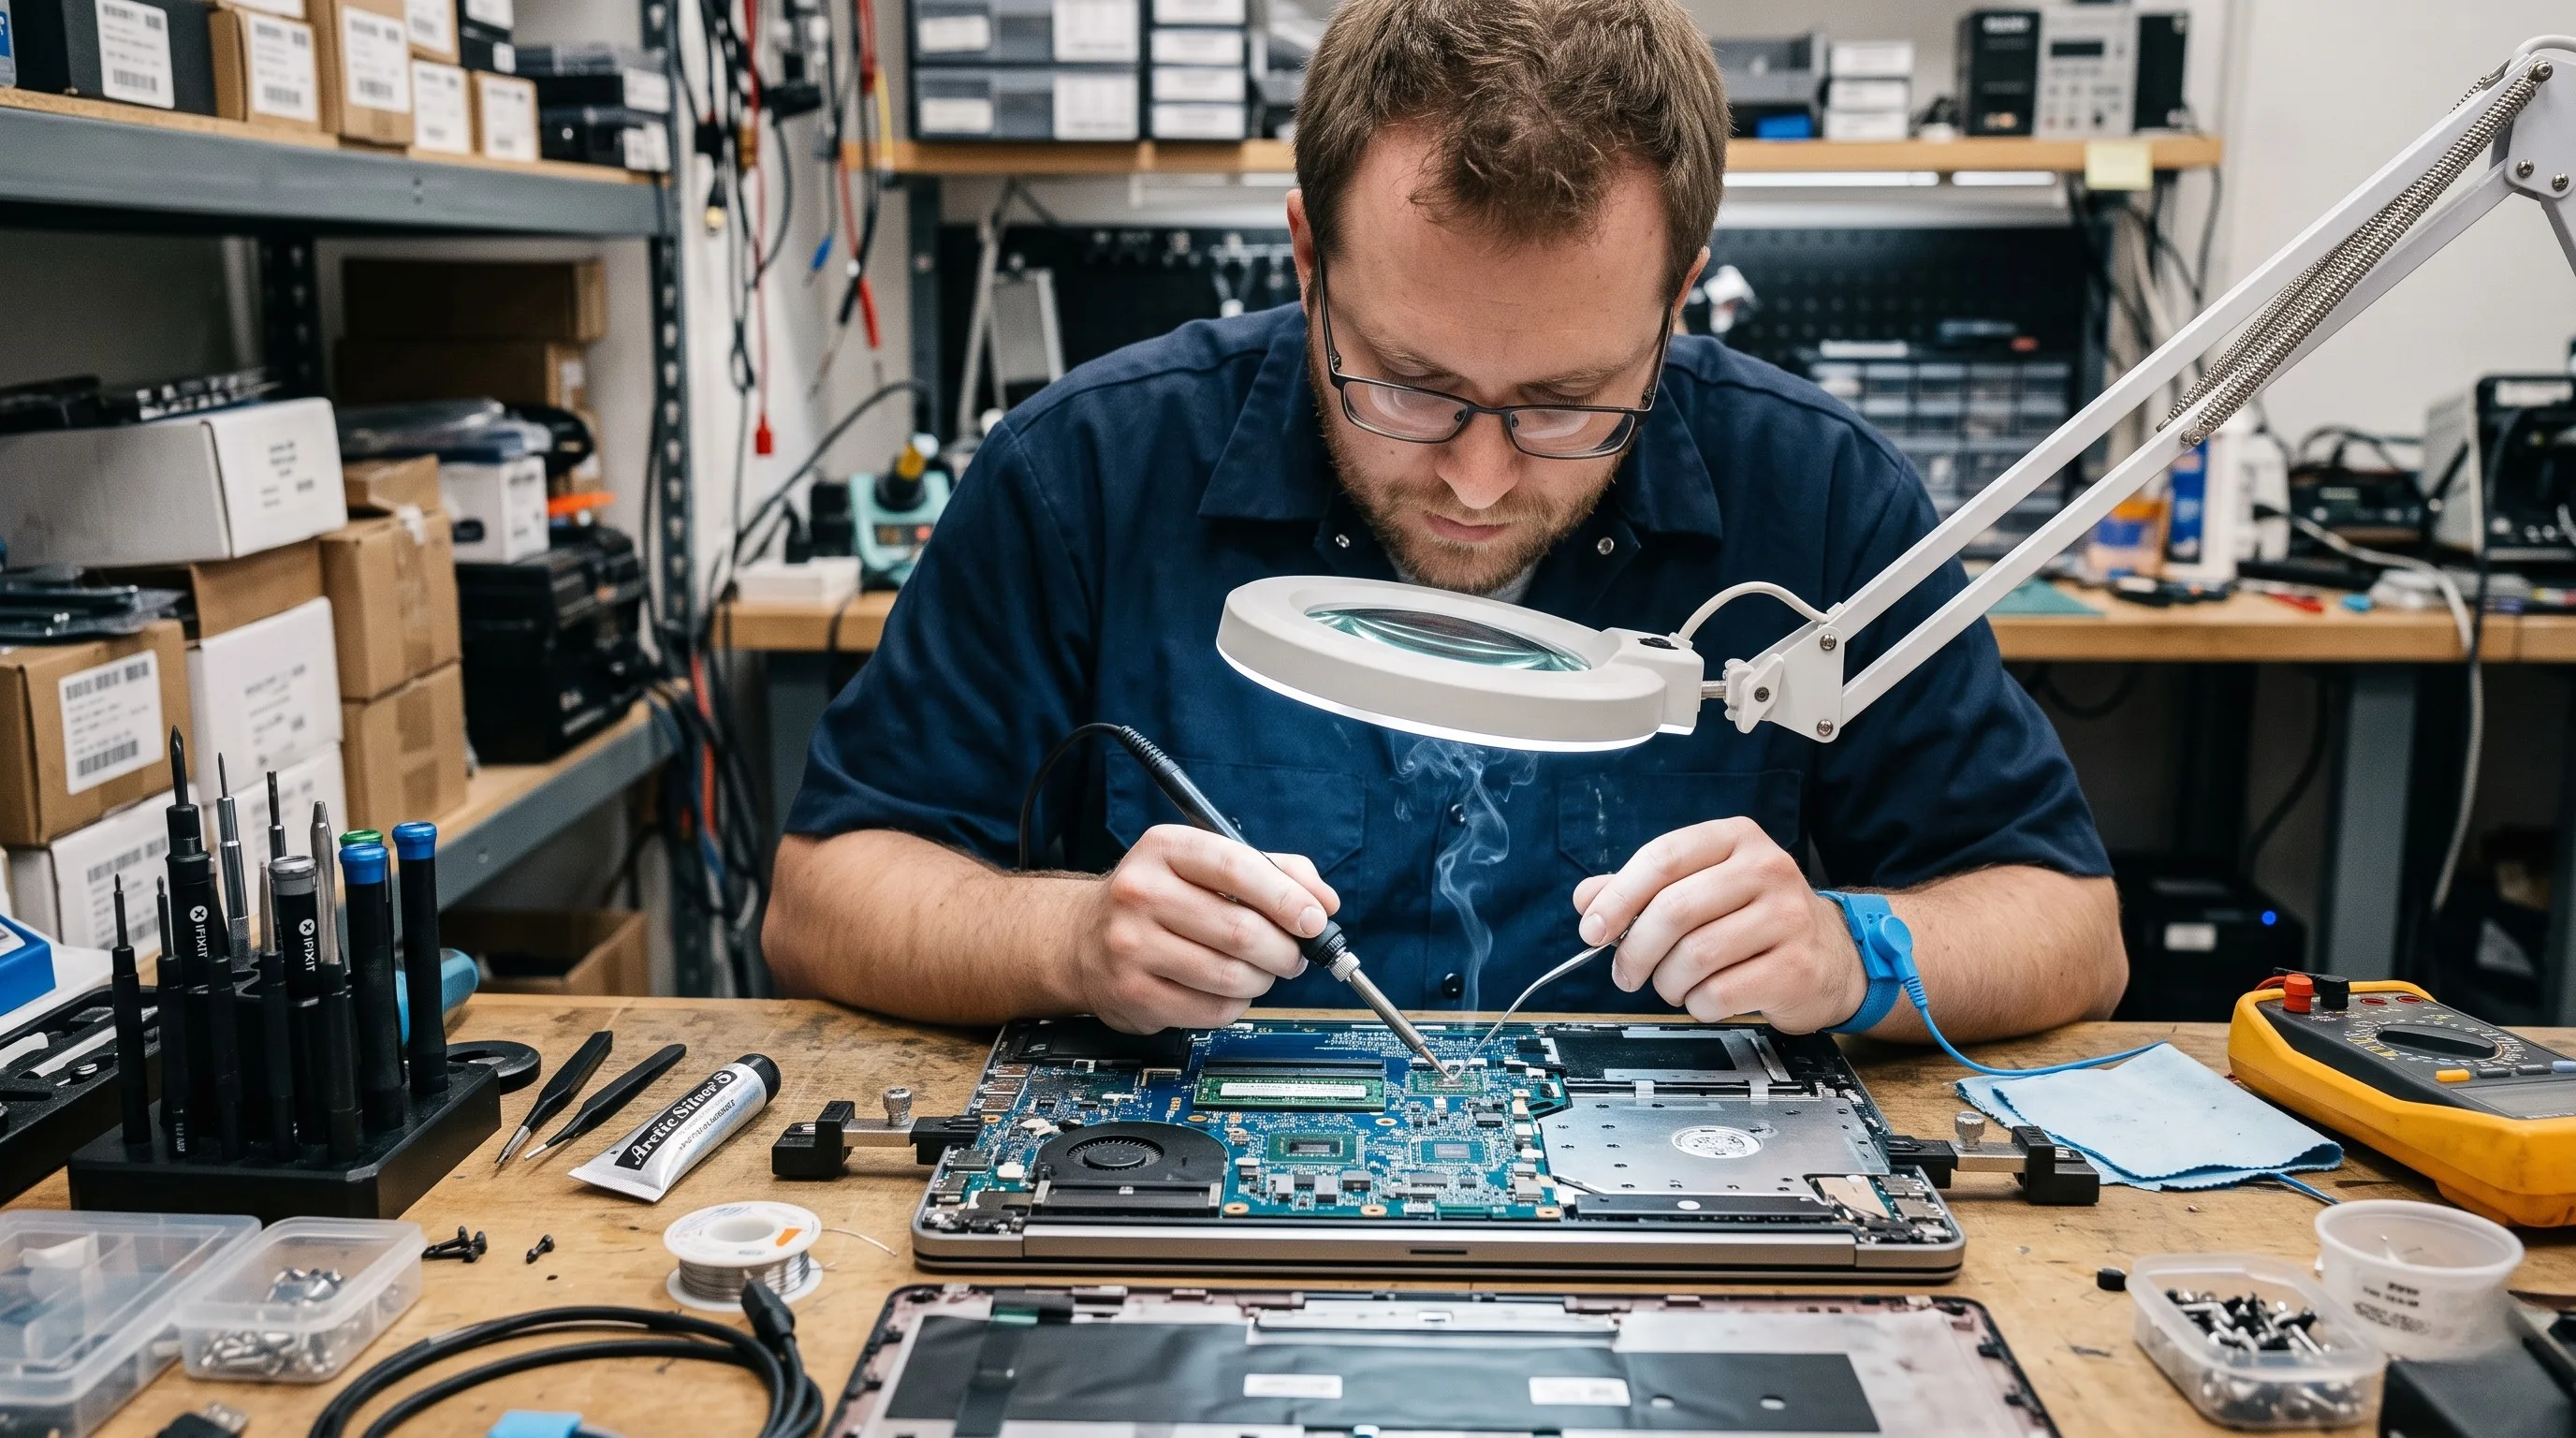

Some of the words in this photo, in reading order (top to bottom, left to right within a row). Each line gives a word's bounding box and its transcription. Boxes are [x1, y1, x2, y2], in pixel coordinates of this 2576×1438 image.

[631, 1118, 679, 1166] Arctic
[673, 1081, 717, 1120] Silver
[713, 1072, 732, 1084] 5
